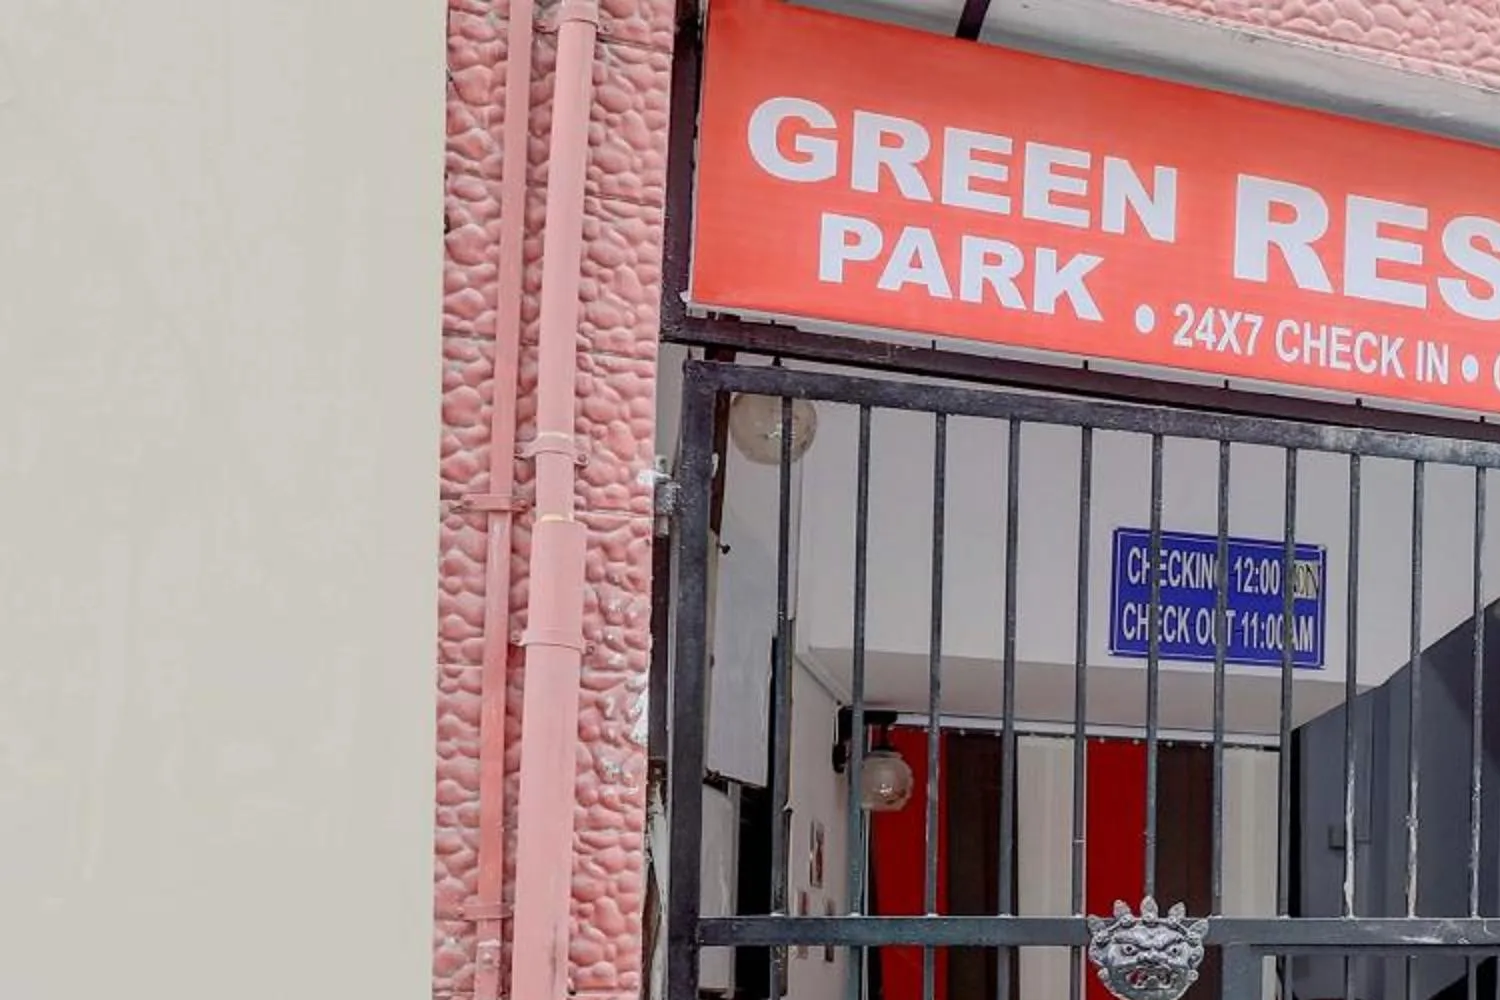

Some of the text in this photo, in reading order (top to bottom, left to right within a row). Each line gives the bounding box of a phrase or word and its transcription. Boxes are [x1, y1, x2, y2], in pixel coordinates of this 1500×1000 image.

[747, 96, 1178, 244] GREEN
[818, 211, 1105, 322] PARK
[1173, 302, 1265, 357] 24X7
[1275, 318, 1406, 379] CHECK
[1415, 339, 1450, 385] IN
[1234, 556, 1281, 595] 12:00
